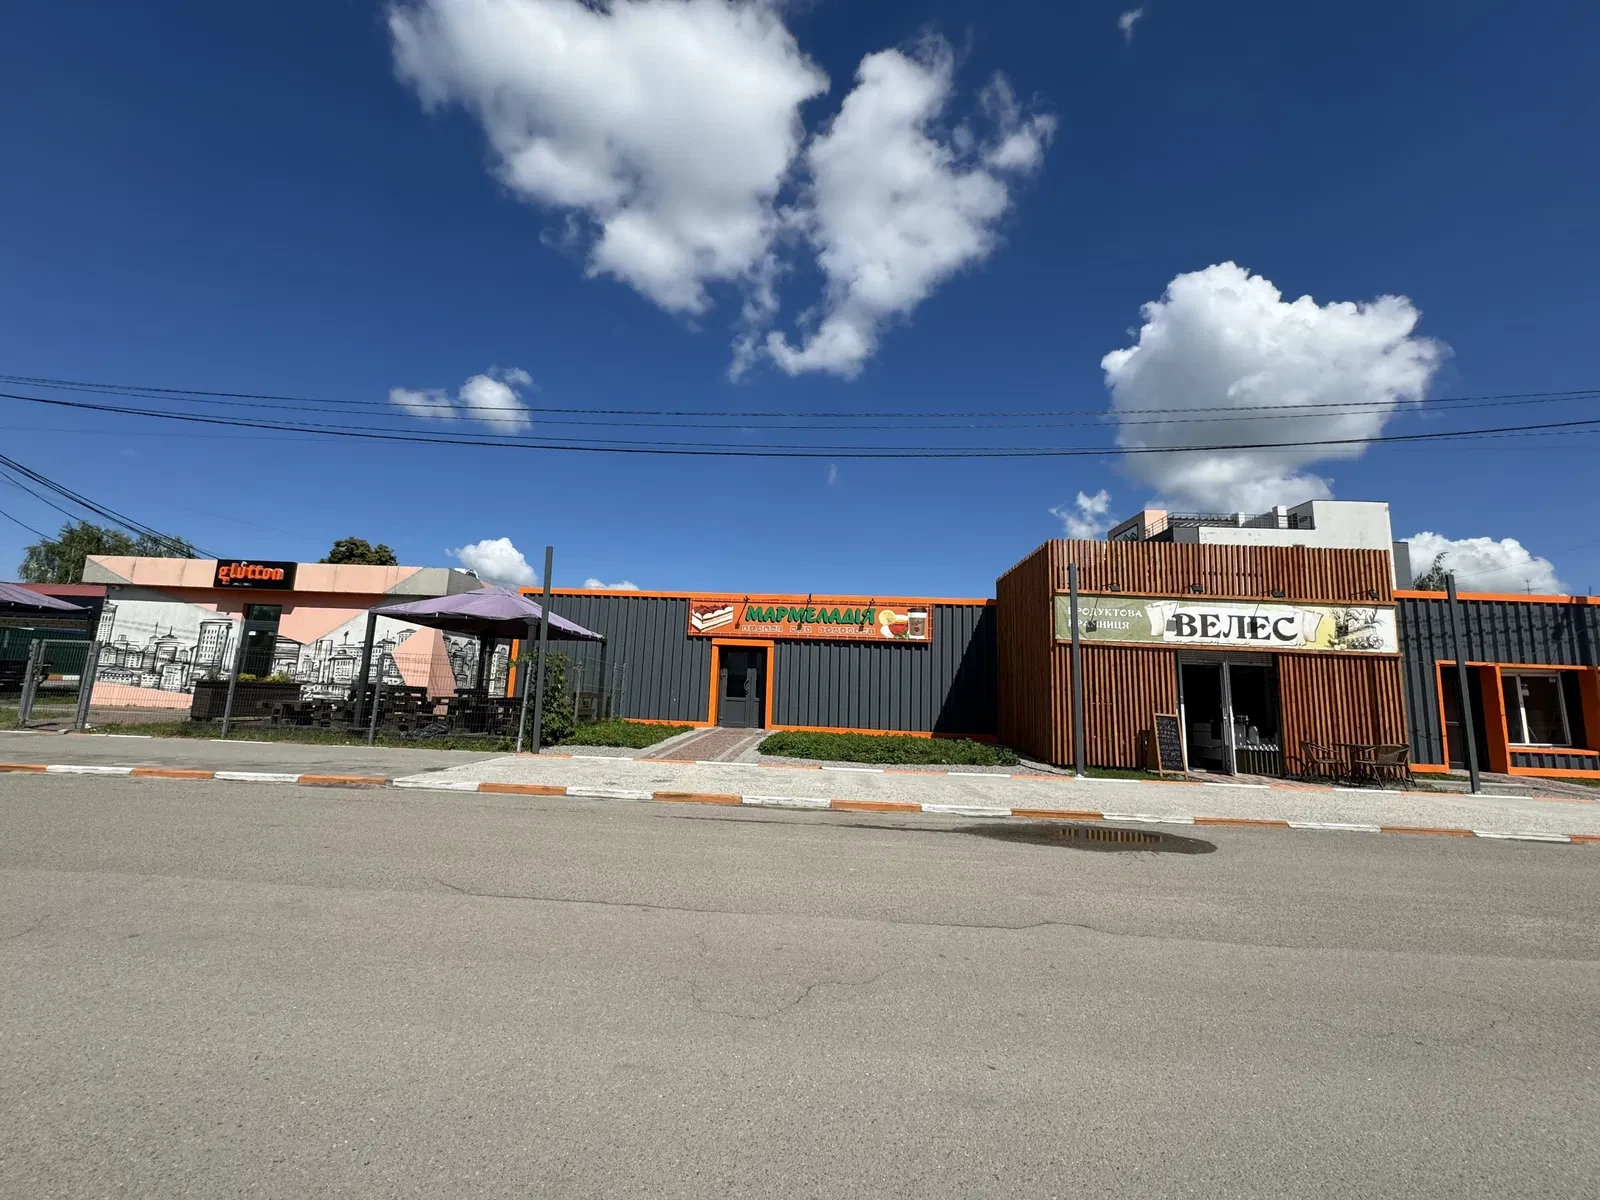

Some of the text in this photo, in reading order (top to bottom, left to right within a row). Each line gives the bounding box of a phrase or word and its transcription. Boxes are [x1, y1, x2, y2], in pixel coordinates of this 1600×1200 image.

[218, 562, 284, 585] glutton
[745, 605, 876, 625] МАРМЕЛАДІЯ
[1172, 613, 1298, 641] ВЕЛЕС
